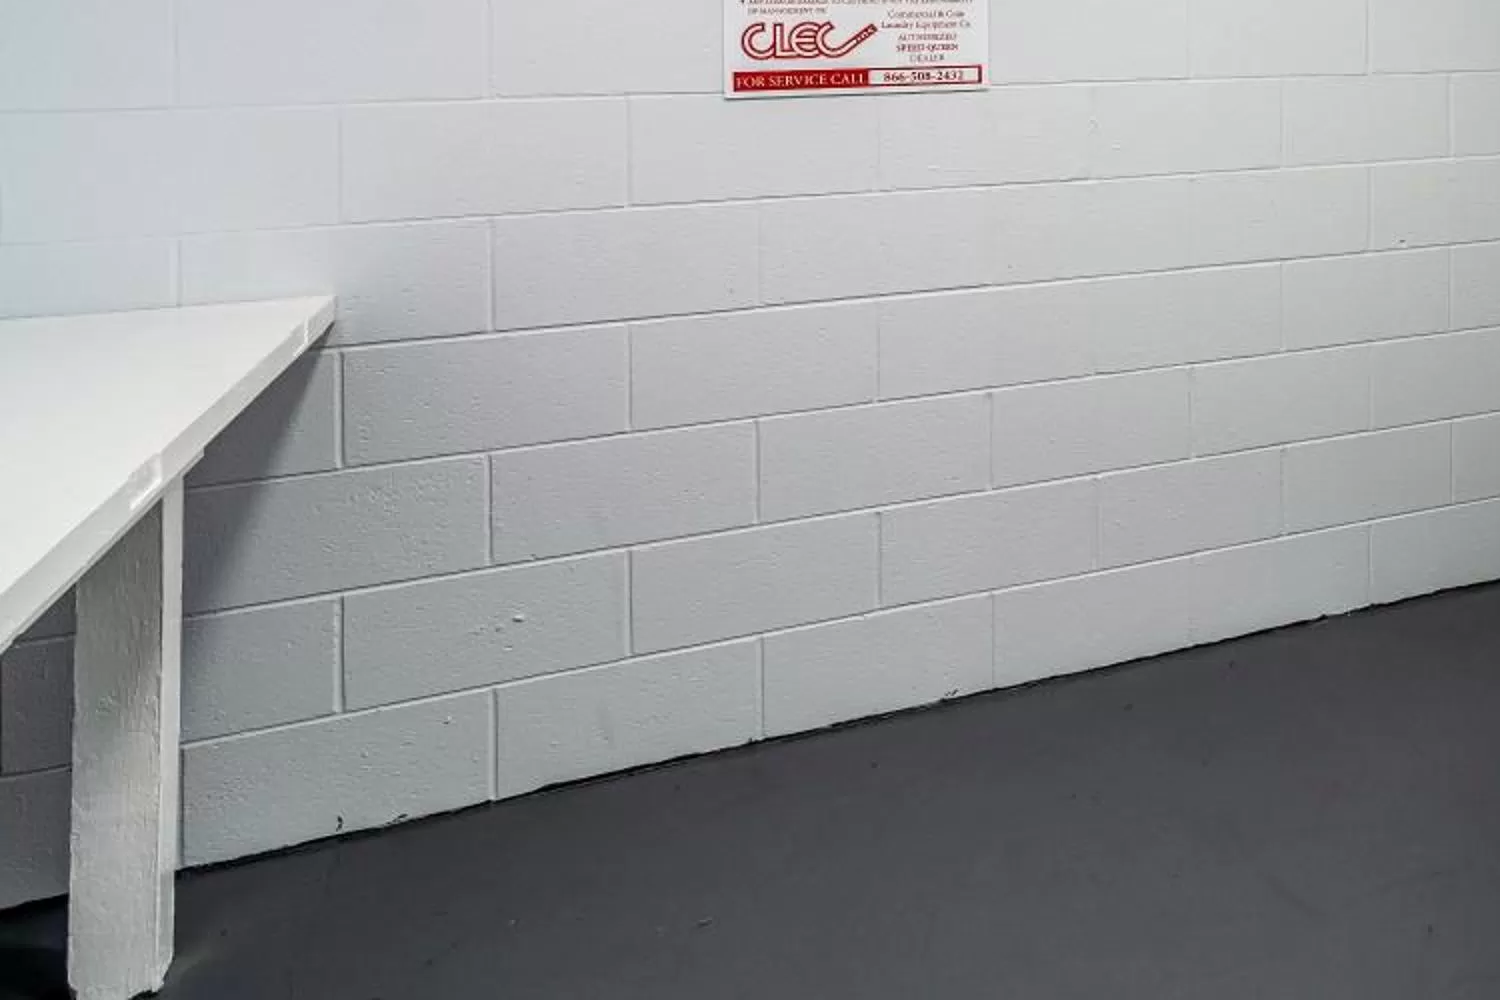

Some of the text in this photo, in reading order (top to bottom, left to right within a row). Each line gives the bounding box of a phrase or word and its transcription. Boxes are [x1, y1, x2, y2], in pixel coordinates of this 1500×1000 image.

[736, 73, 865, 88] FOR SERVICE CALL
